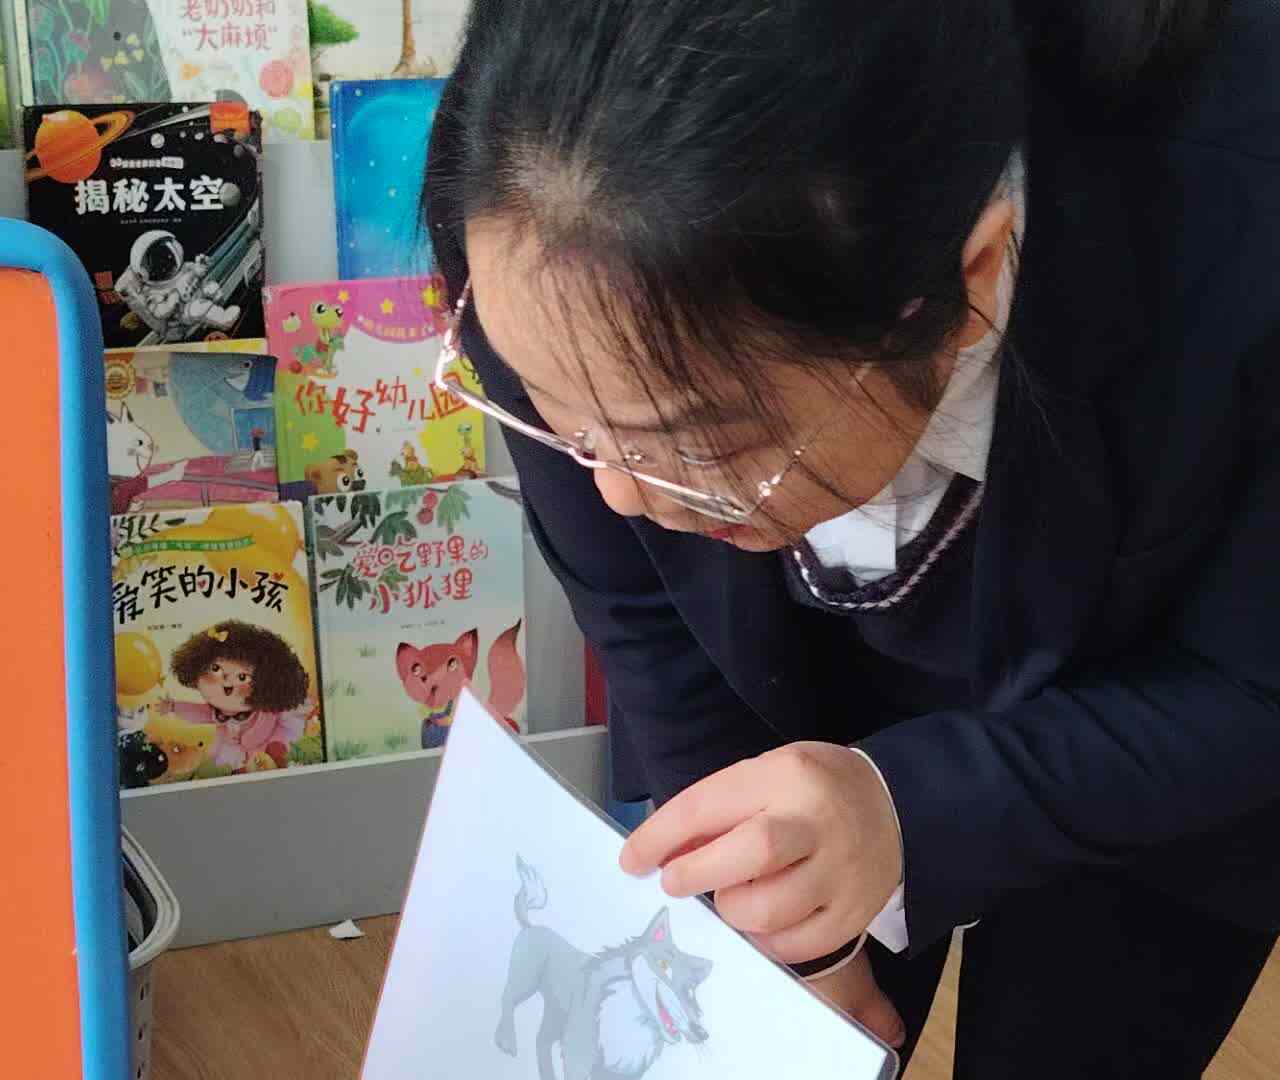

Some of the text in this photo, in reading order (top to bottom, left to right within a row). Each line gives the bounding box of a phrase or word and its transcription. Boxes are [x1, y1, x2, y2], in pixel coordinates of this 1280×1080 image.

[74, 174, 224, 215] 揭秘太空
[295, 373, 469, 432] 你好幼儿园
[352, 533, 489, 578] 爱吃野果的
[369, 567, 473, 614] 小狐狸
